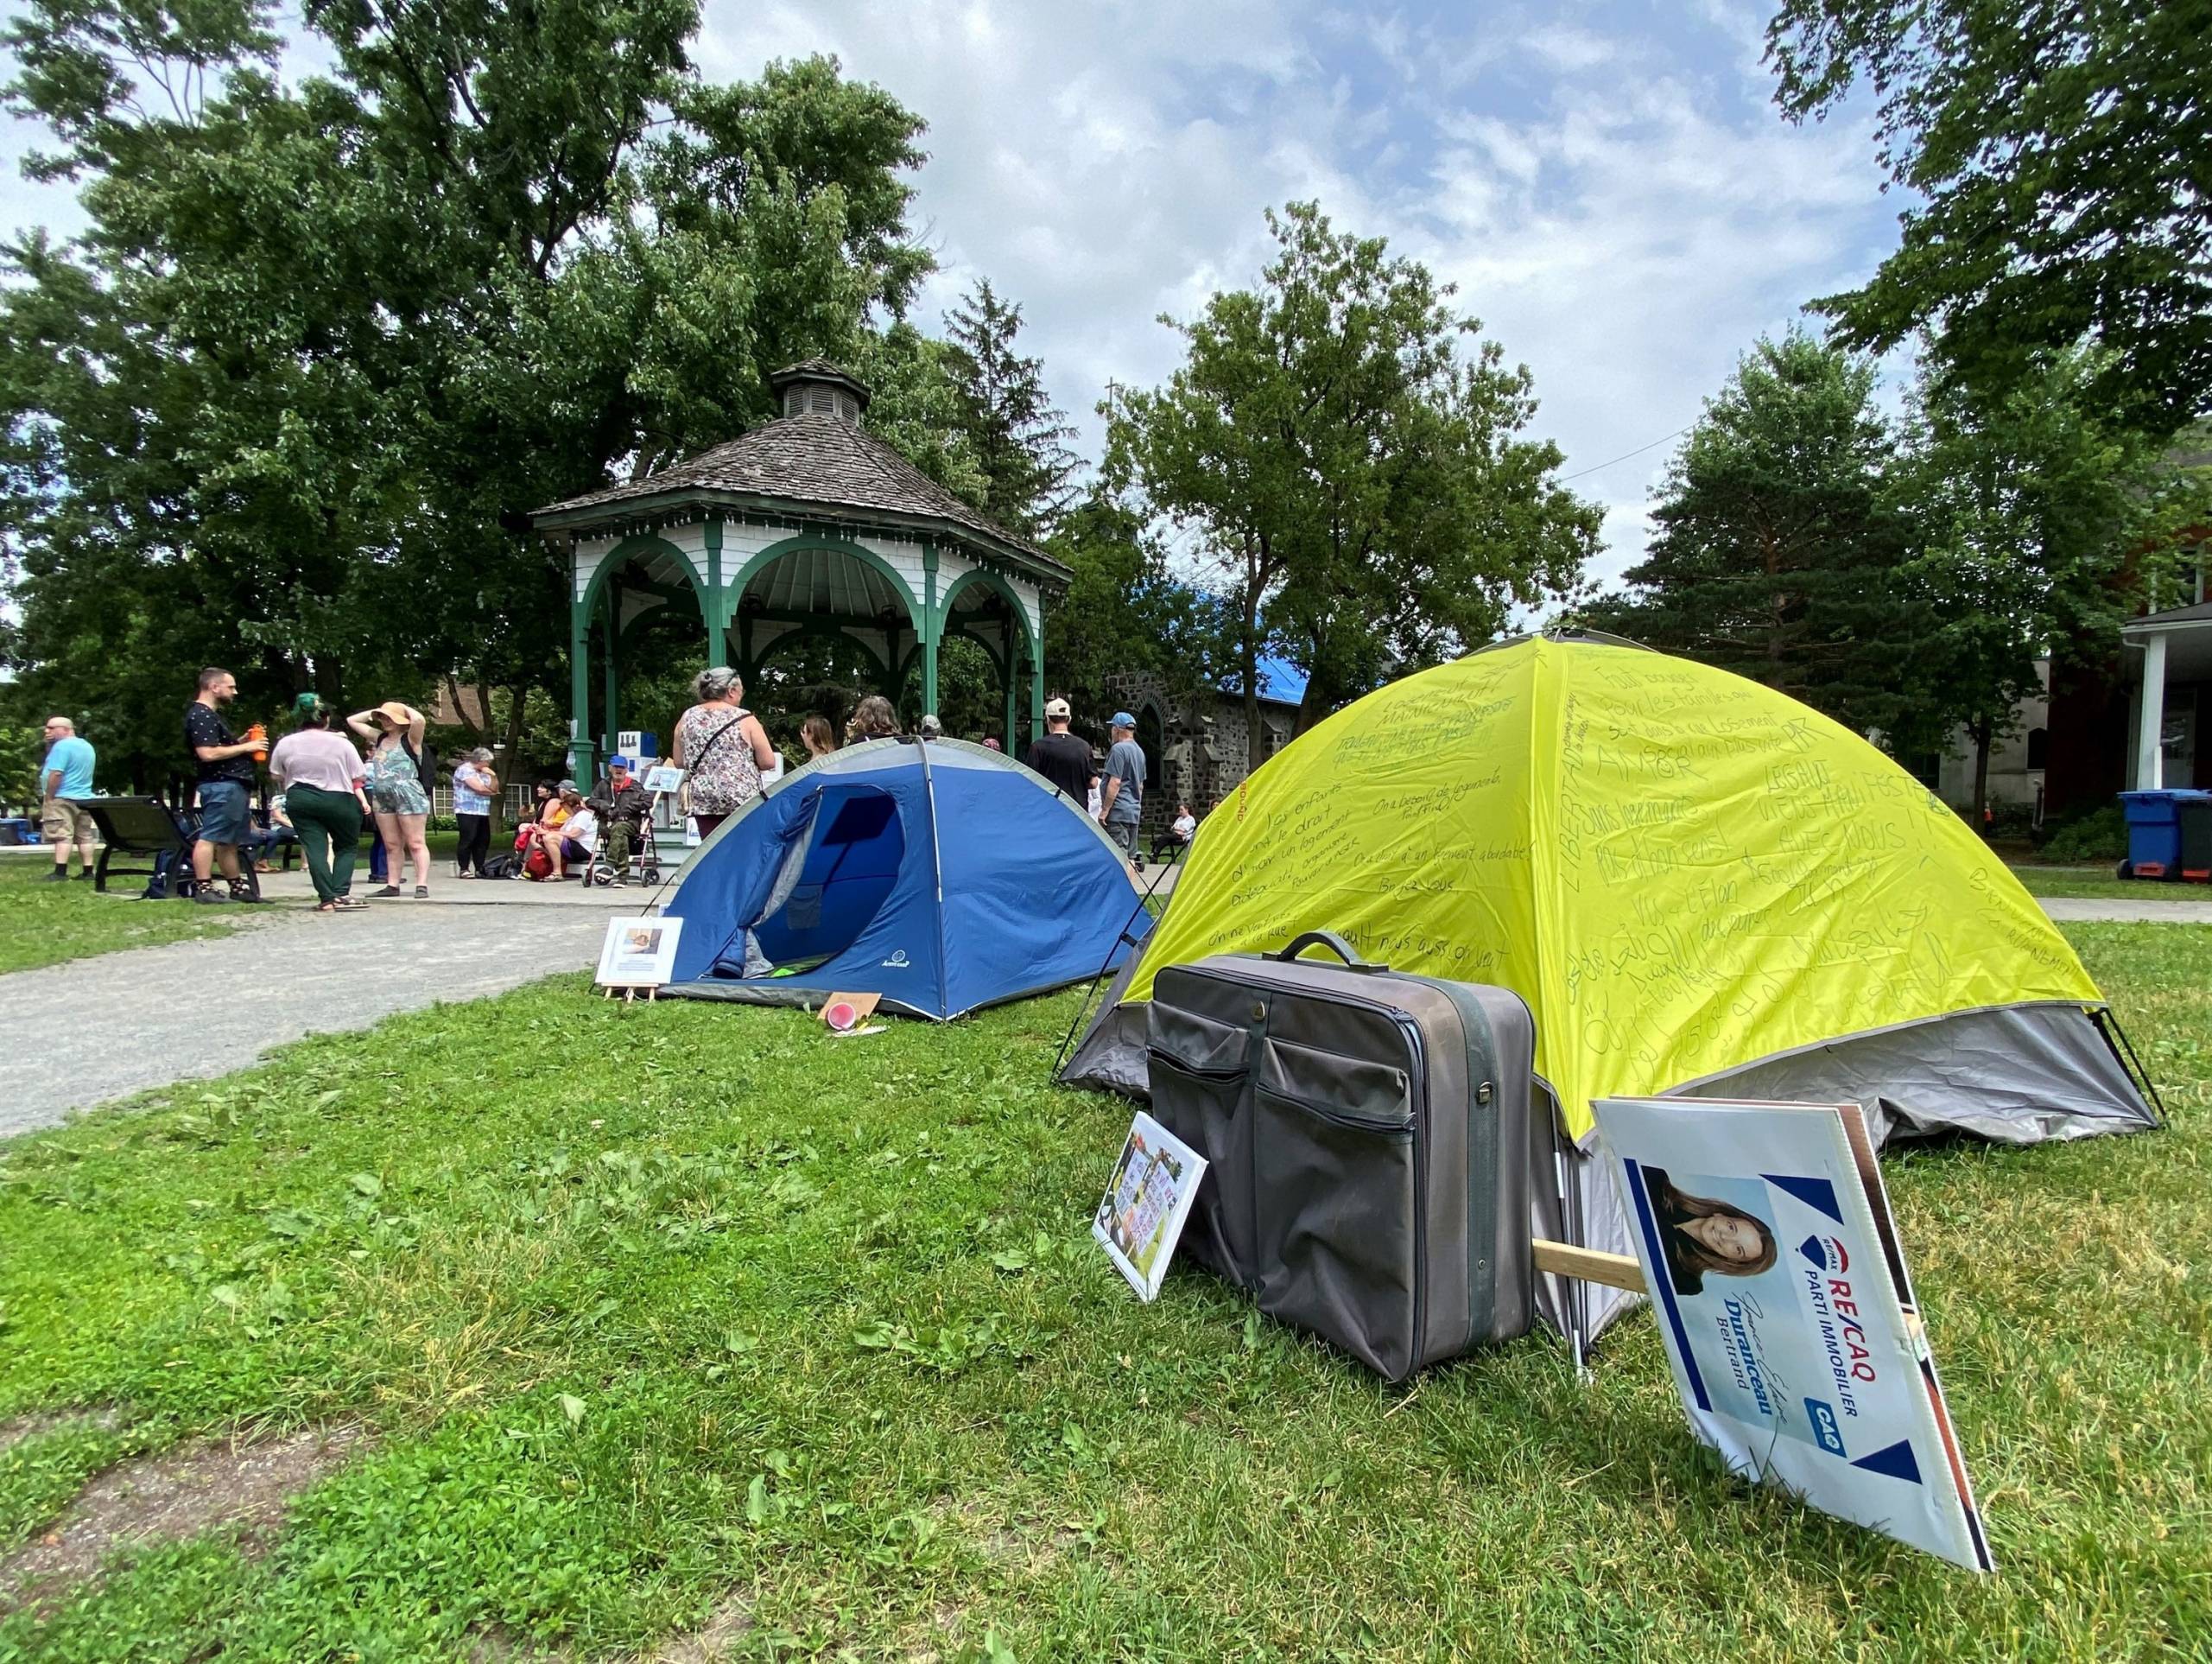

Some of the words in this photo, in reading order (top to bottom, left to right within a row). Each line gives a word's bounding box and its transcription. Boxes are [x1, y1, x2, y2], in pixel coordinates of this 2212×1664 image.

[1558, 747, 1583, 893] LIBERTAD
[1842, 819, 1907, 852] NOUS
[1822, 1237, 1840, 1271] RE/MAX
[1715, 1315, 1750, 1390] Bertrand
[1723, 1298, 1773, 1417] Duranceau
[1803, 1270, 1829, 1316] PARTI
[1818, 1319, 1859, 1418] IMMOBILIER
[1826, 1278, 1877, 1383] RE/CAQ
